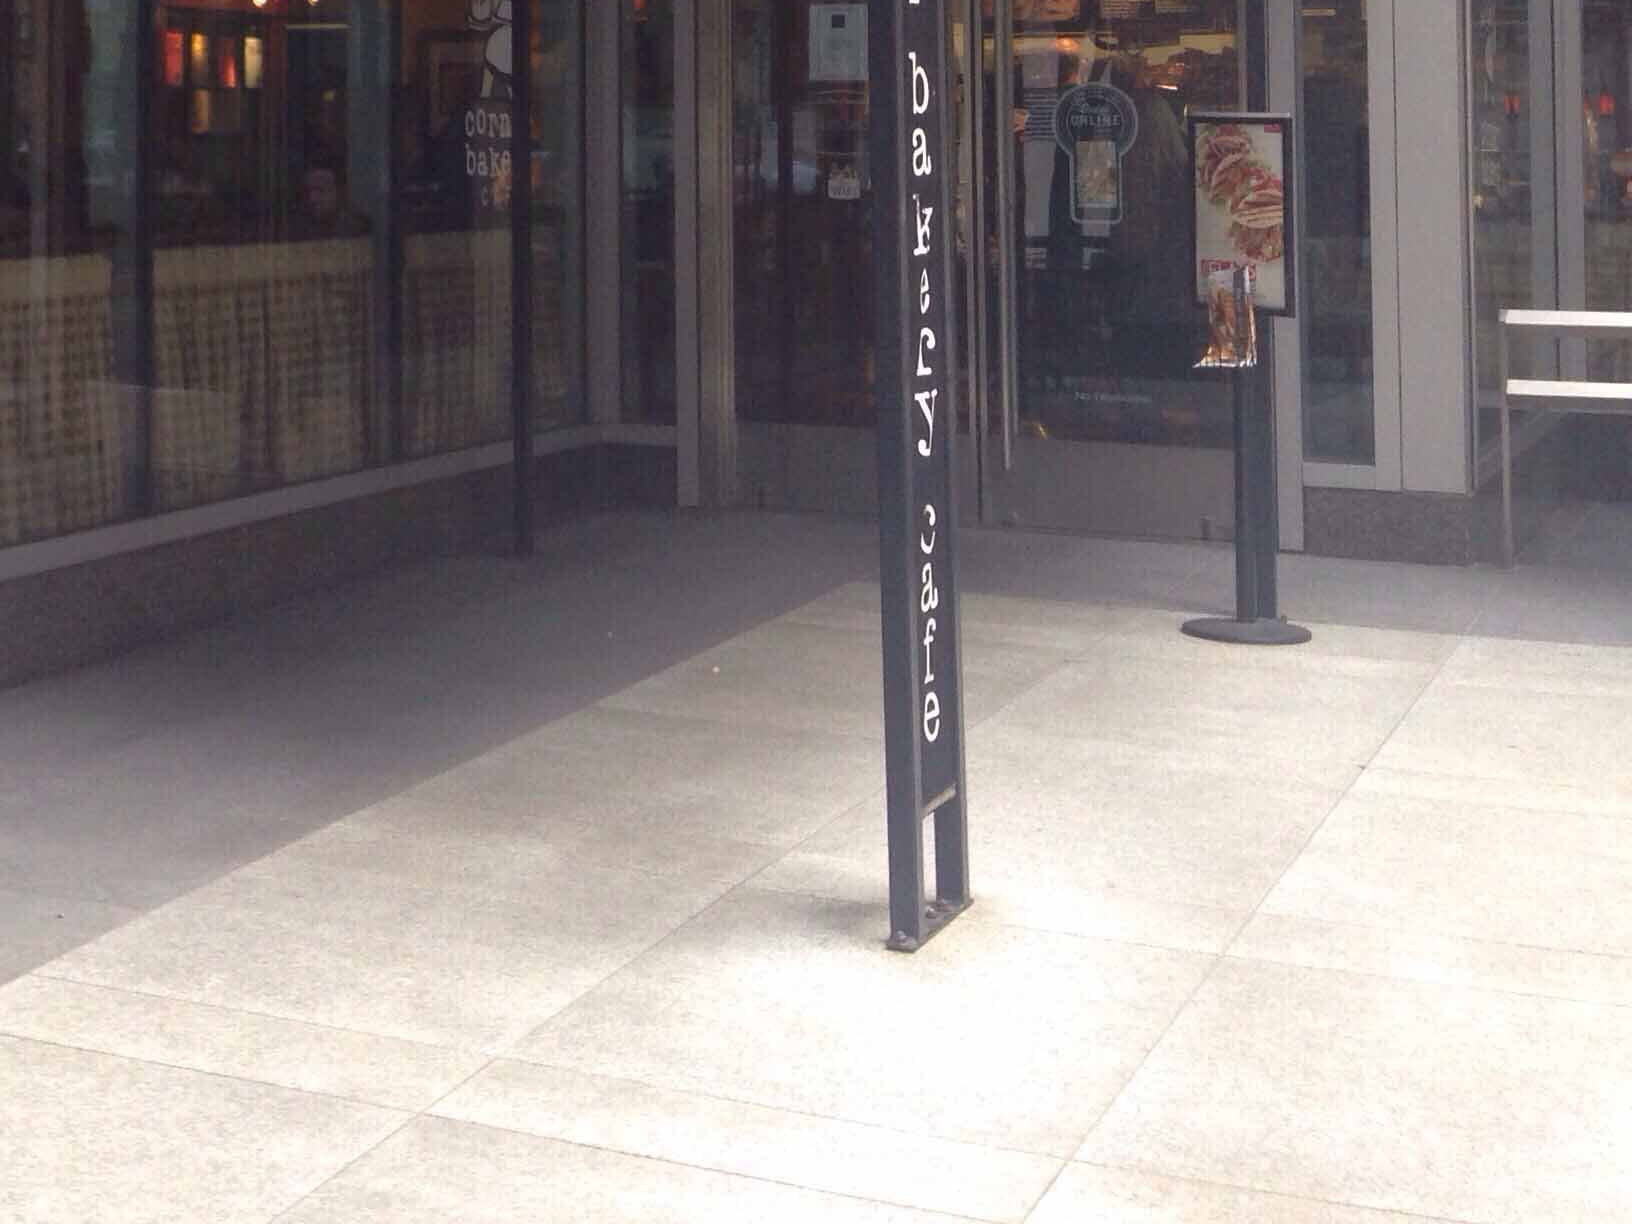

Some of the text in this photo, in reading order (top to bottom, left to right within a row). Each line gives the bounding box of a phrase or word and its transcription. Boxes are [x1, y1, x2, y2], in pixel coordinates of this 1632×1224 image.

[465, 108, 513, 139] corn
[465, 143, 513, 176] bake
[908, 52, 938, 456] bakery
[920, 504, 941, 743] cafe
